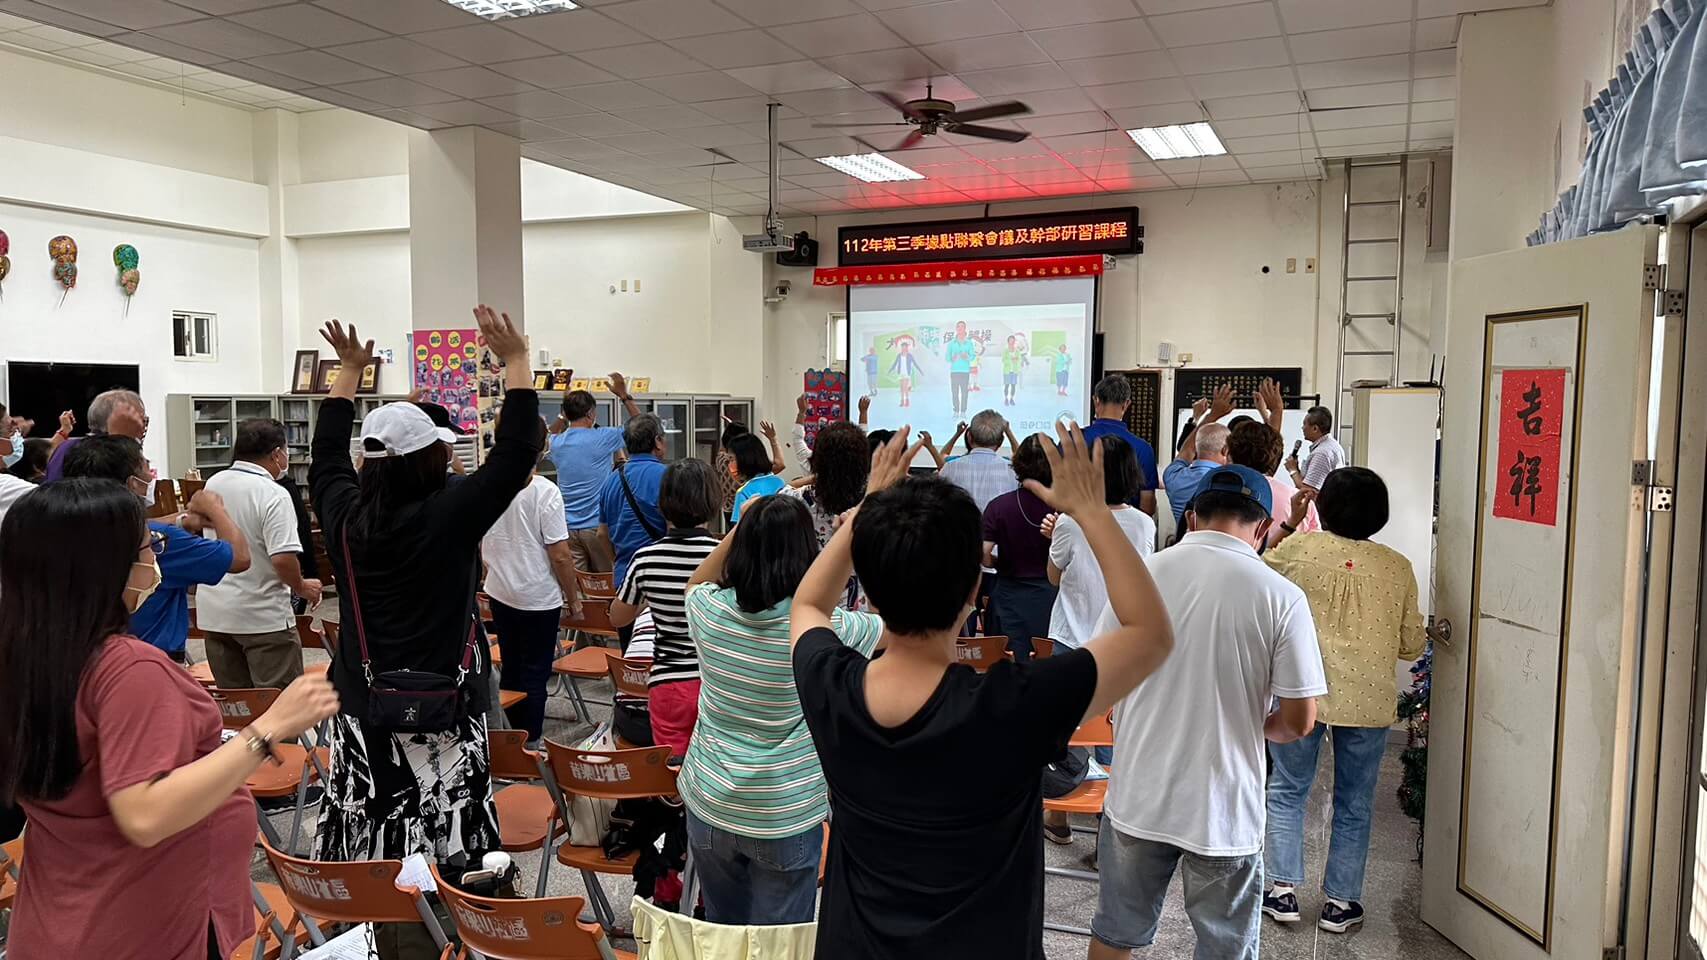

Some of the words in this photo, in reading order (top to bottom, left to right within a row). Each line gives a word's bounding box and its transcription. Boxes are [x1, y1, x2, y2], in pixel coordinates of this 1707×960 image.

[843, 220, 1128, 254] 112年第三季據點聯繫會議及幹部研習課程
[1509, 380, 1543, 517] 吉祥
